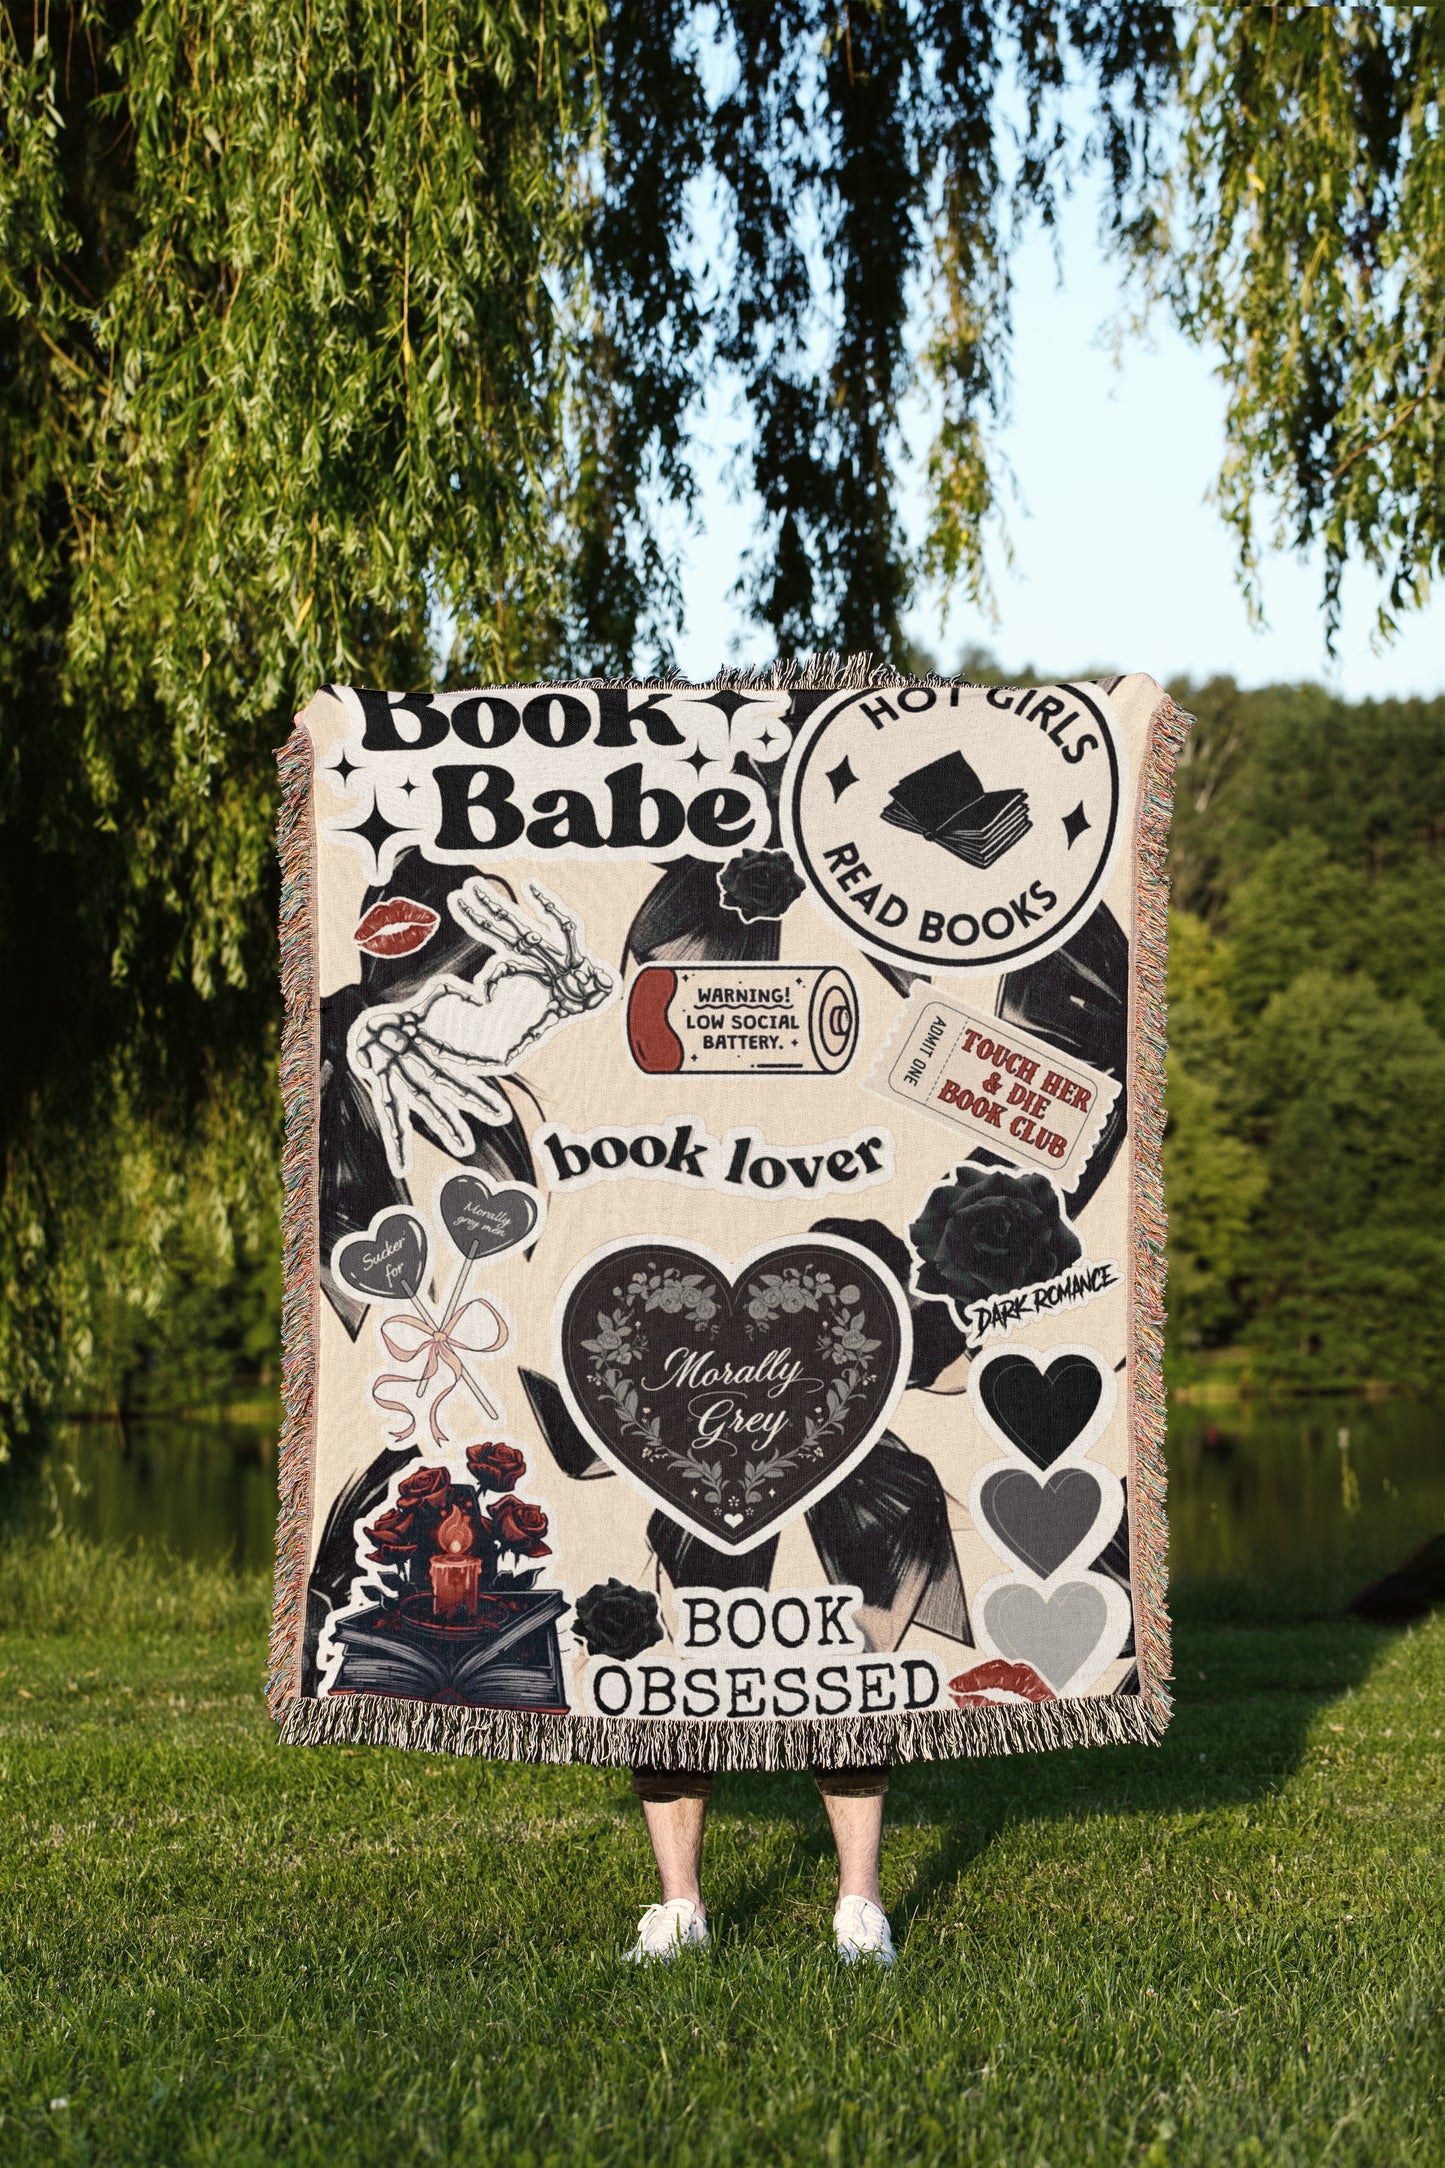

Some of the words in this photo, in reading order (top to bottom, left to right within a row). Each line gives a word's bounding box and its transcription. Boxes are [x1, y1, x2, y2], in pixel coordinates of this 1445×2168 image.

[362, 687, 685, 751] Book
[986, 688, 1099, 763] GIRLS
[432, 763, 756, 850] Babe
[823, 842, 909, 927] READ
[918, 880, 1057, 946] BOOKS
[698, 987, 790, 1003] WARNING!
[686, 1014, 725, 1030] LOW
[732, 1014, 800, 1030] SOCIAL
[703, 1035, 784, 1050] BATTERY.
[920, 1015, 947, 1058] ADMIT
[904, 1058, 926, 1087] ONE
[961, 1028, 1040, 1085] TOUCH
[1040, 1070, 1092, 1113] HER
[982, 1071, 1003, 1095] &
[1006, 1083, 1051, 1119] DIE
[937, 1079, 1008, 1128] BOOK
[1009, 1116, 1068, 1159] CLUB
[544, 1125, 708, 1181] book
[724, 1137, 883, 1188] lover
[453, 1216, 480, 1231] grey
[481, 1225, 506, 1237] men
[463, 1201, 511, 1228] Morally
[362, 1235, 406, 1271] Sucker
[385, 1262, 404, 1288] for
[972, 1294, 1034, 1339] DARK
[1031, 1264, 1120, 1315] ROMANCE
[641, 1347, 824, 1398] Morally
[688, 1391, 790, 1457] Grey
[682, 1596, 854, 1649] BOOK
[593, 1659, 940, 1717] OBSESSED
